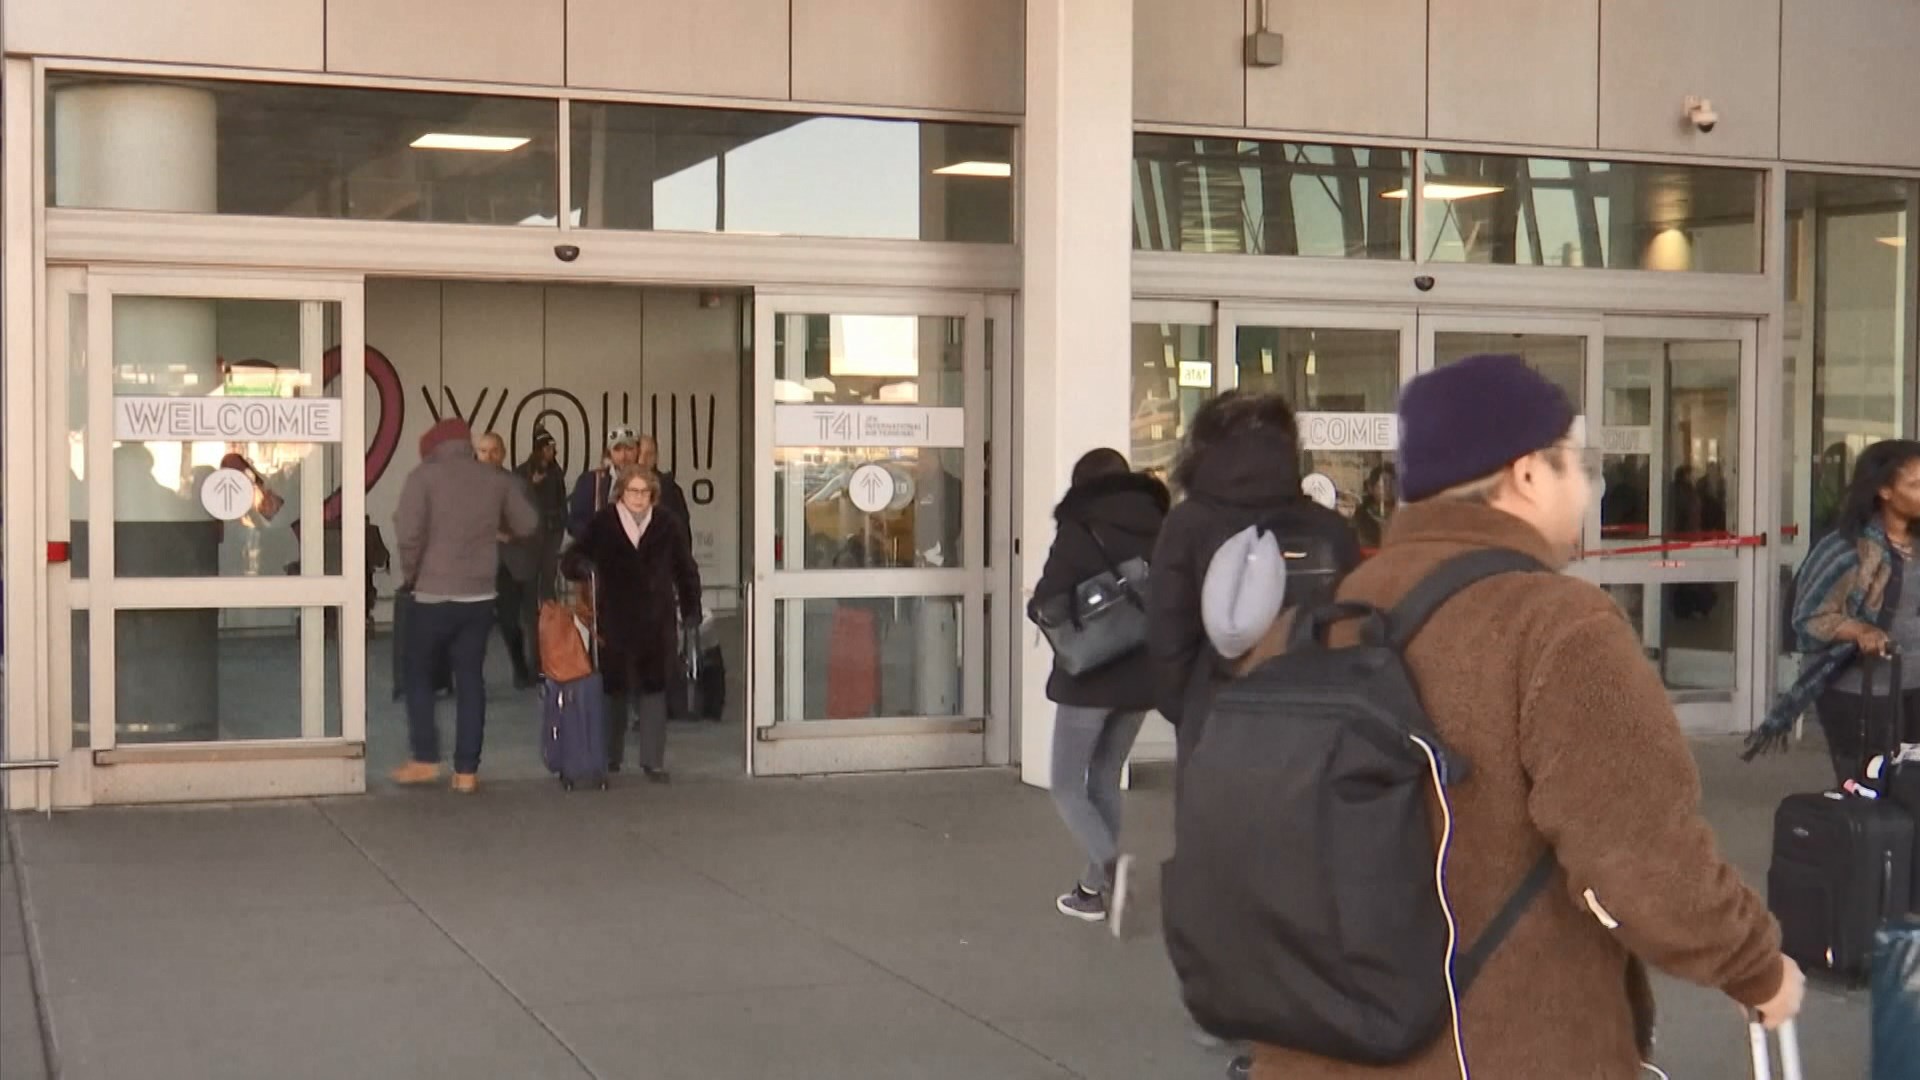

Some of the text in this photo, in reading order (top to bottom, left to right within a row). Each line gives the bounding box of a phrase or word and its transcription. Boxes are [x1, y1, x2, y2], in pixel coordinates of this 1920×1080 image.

[125, 402, 330, 436] WELCOME
[813, 410, 852, 441] T4
[1309, 417, 1390, 447] COME
